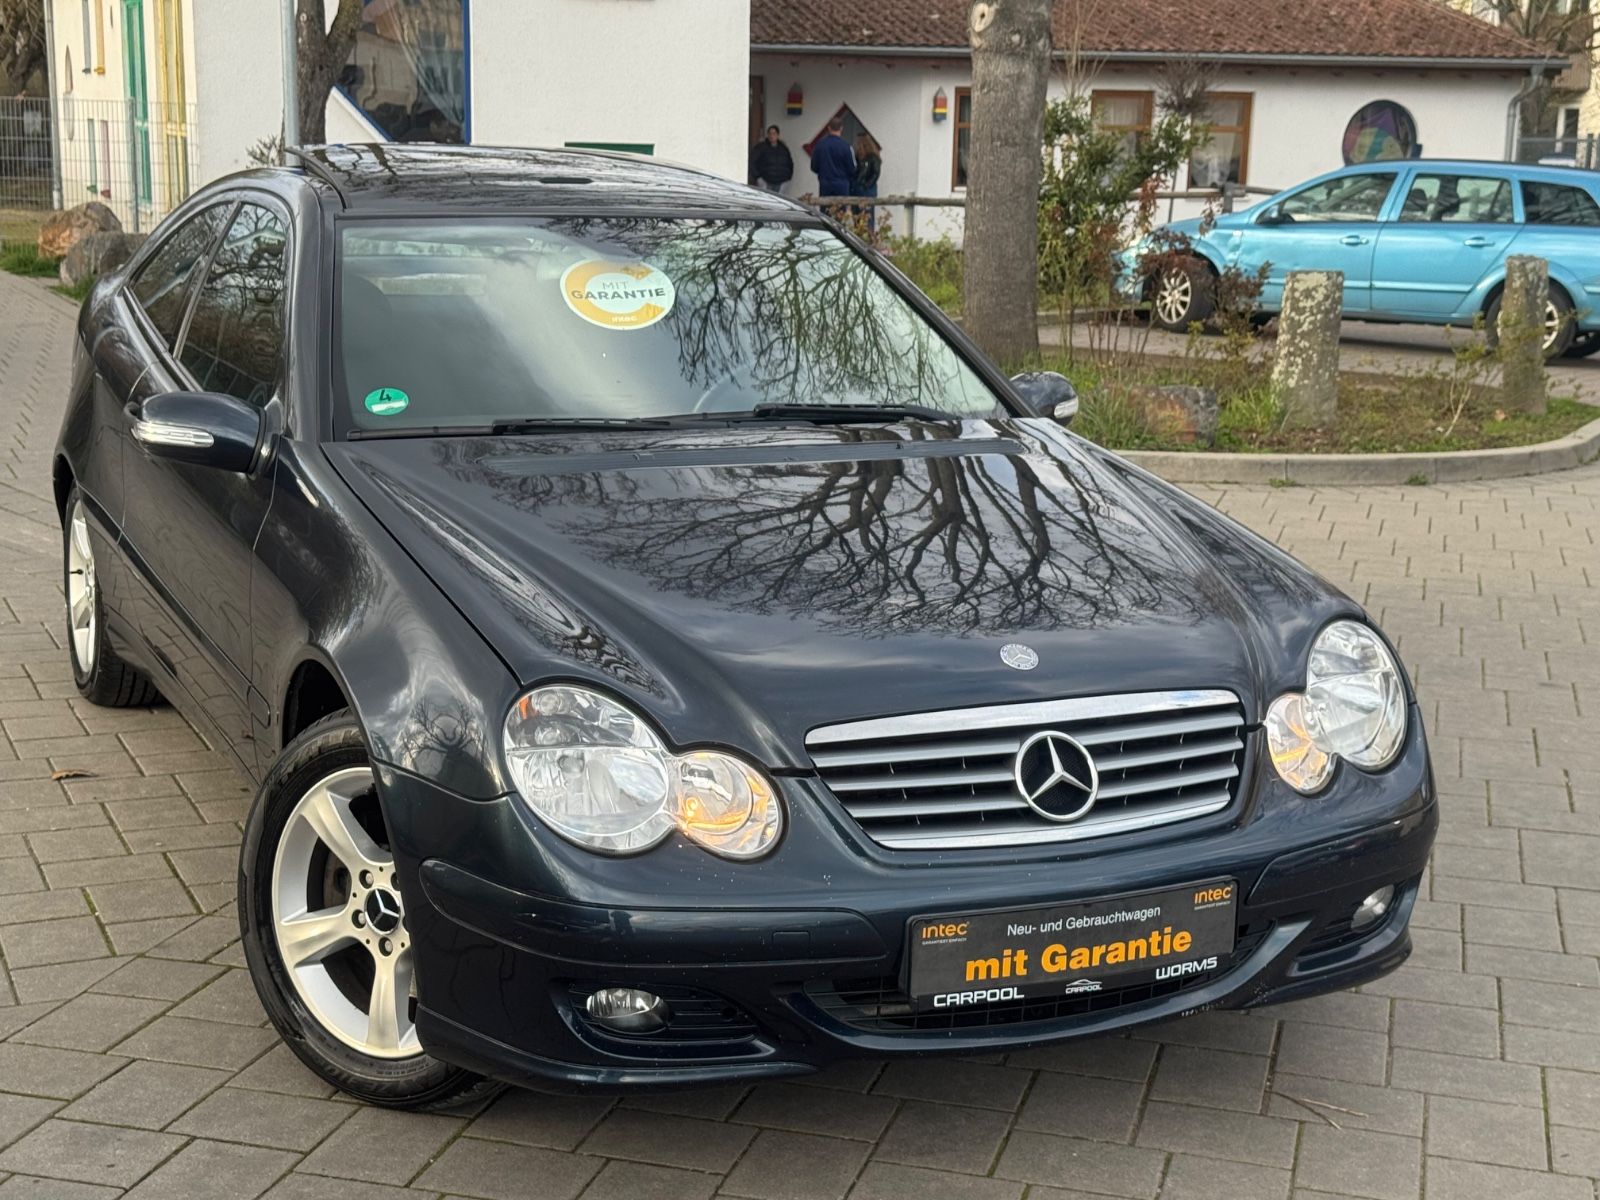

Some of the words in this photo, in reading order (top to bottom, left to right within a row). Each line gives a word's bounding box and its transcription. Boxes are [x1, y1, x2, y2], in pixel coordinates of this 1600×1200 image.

[571, 287, 666, 300] GARANTIE
[602, 281, 628, 291] MIT
[379, 389, 392, 401] 4
[1194, 887, 1231, 904] intec
[1007, 923, 1037, 936] Neu-
[1040, 919, 1063, 932] und
[1066, 906, 1161, 929] Gebrauchtwagen
[922, 923, 968, 939] intec
[965, 948, 1028, 981] mit
[1041, 927, 1192, 973] Garantie
[1155, 957, 1218, 980] WORMS
[1065, 984, 1103, 994] CARPOOL
[933, 987, 1025, 1008] CARPOOL
